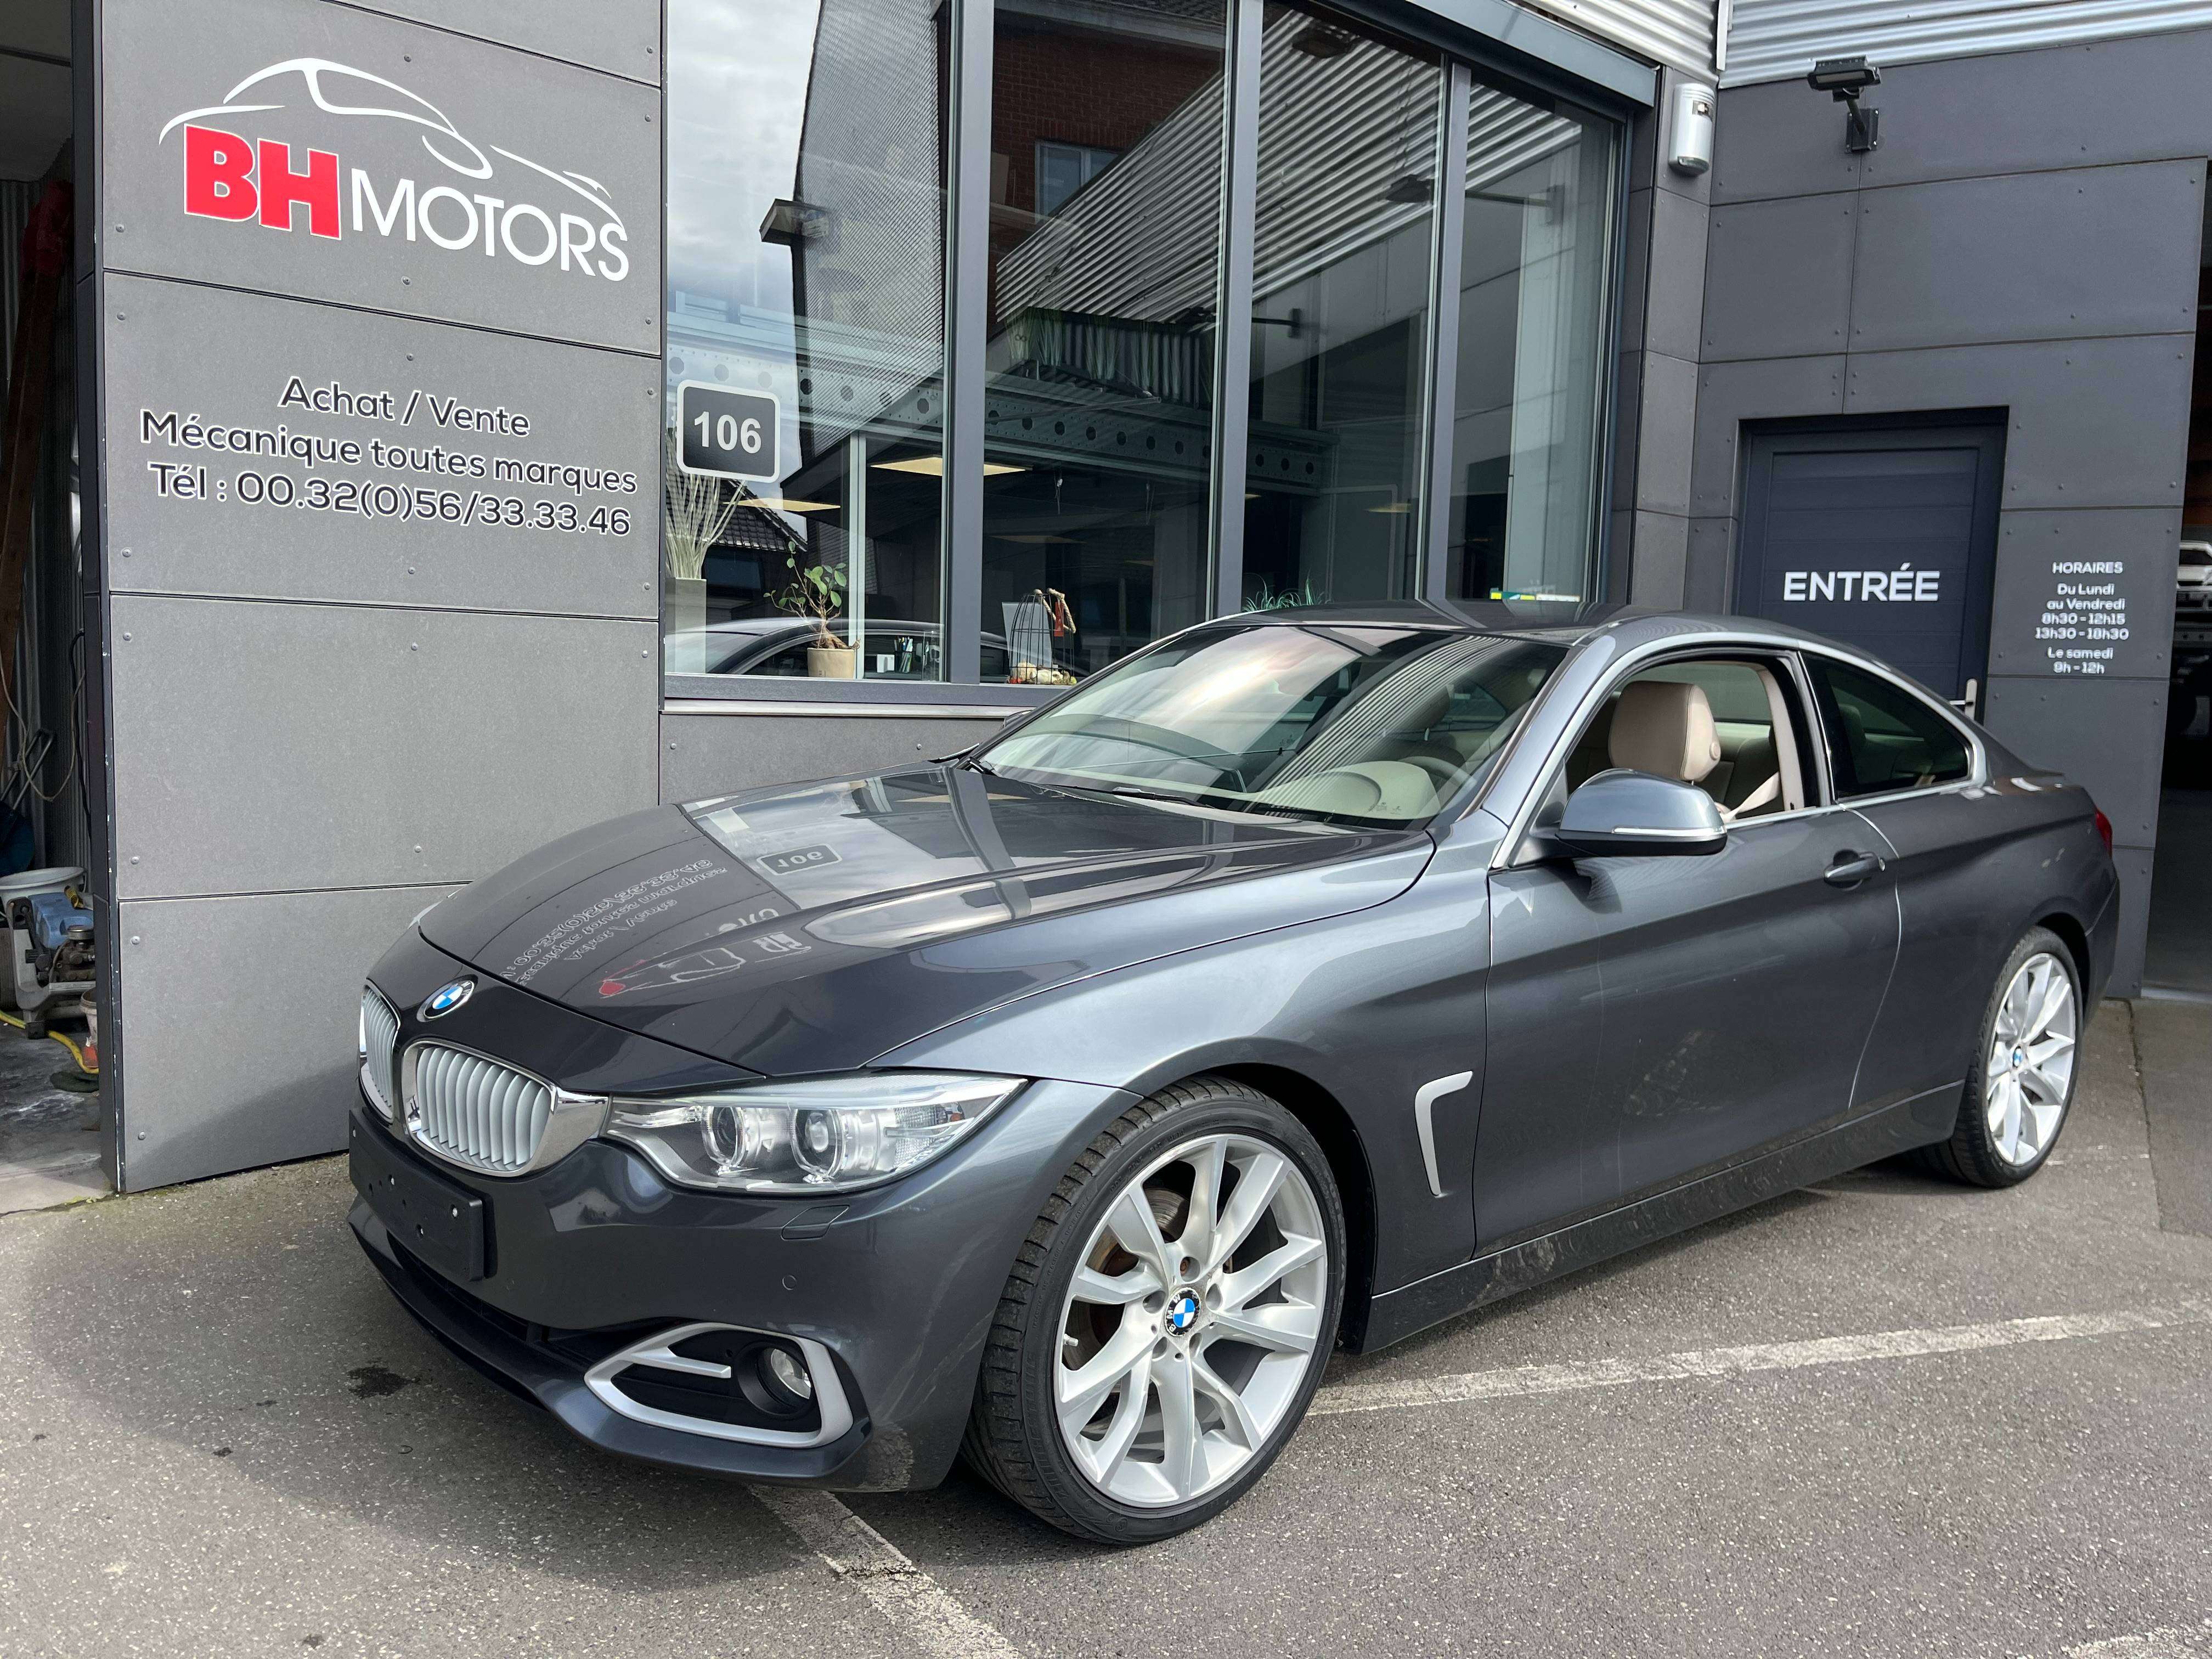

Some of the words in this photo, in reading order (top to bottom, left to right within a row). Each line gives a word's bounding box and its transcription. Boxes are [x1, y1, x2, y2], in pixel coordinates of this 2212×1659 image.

[183, 123, 341, 240] BH
[351, 168, 629, 281] MOTORS
[278, 376, 394, 422] Achat
[400, 390, 421, 427] /
[426, 394, 531, 438] Vente
[694, 411, 761, 454] 106
[140, 409, 362, 469] Mécanique
[370, 439, 484, 478] toutes
[494, 455, 637, 496] marques
[148, 461, 207, 501] Tél
[236, 473, 631, 537] 00.32(0)56/33.33.46
[2052, 562, 2123, 574] HORAIRES
[1783, 562, 1940, 601] ENTRÉE
[2057, 583, 2076, 595] Du
[2078, 583, 2115, 595] Lundi
[2046, 601, 2064, 611] au
[2066, 598, 2125, 611] Vendredi
[2087, 613, 2126, 625] 12h15
[2035, 627, 2077, 640] 13h30
[2047, 647, 2064, 659] Le
[2066, 647, 2114, 660] samedi
[2081, 662, 2104, 675] 12h
